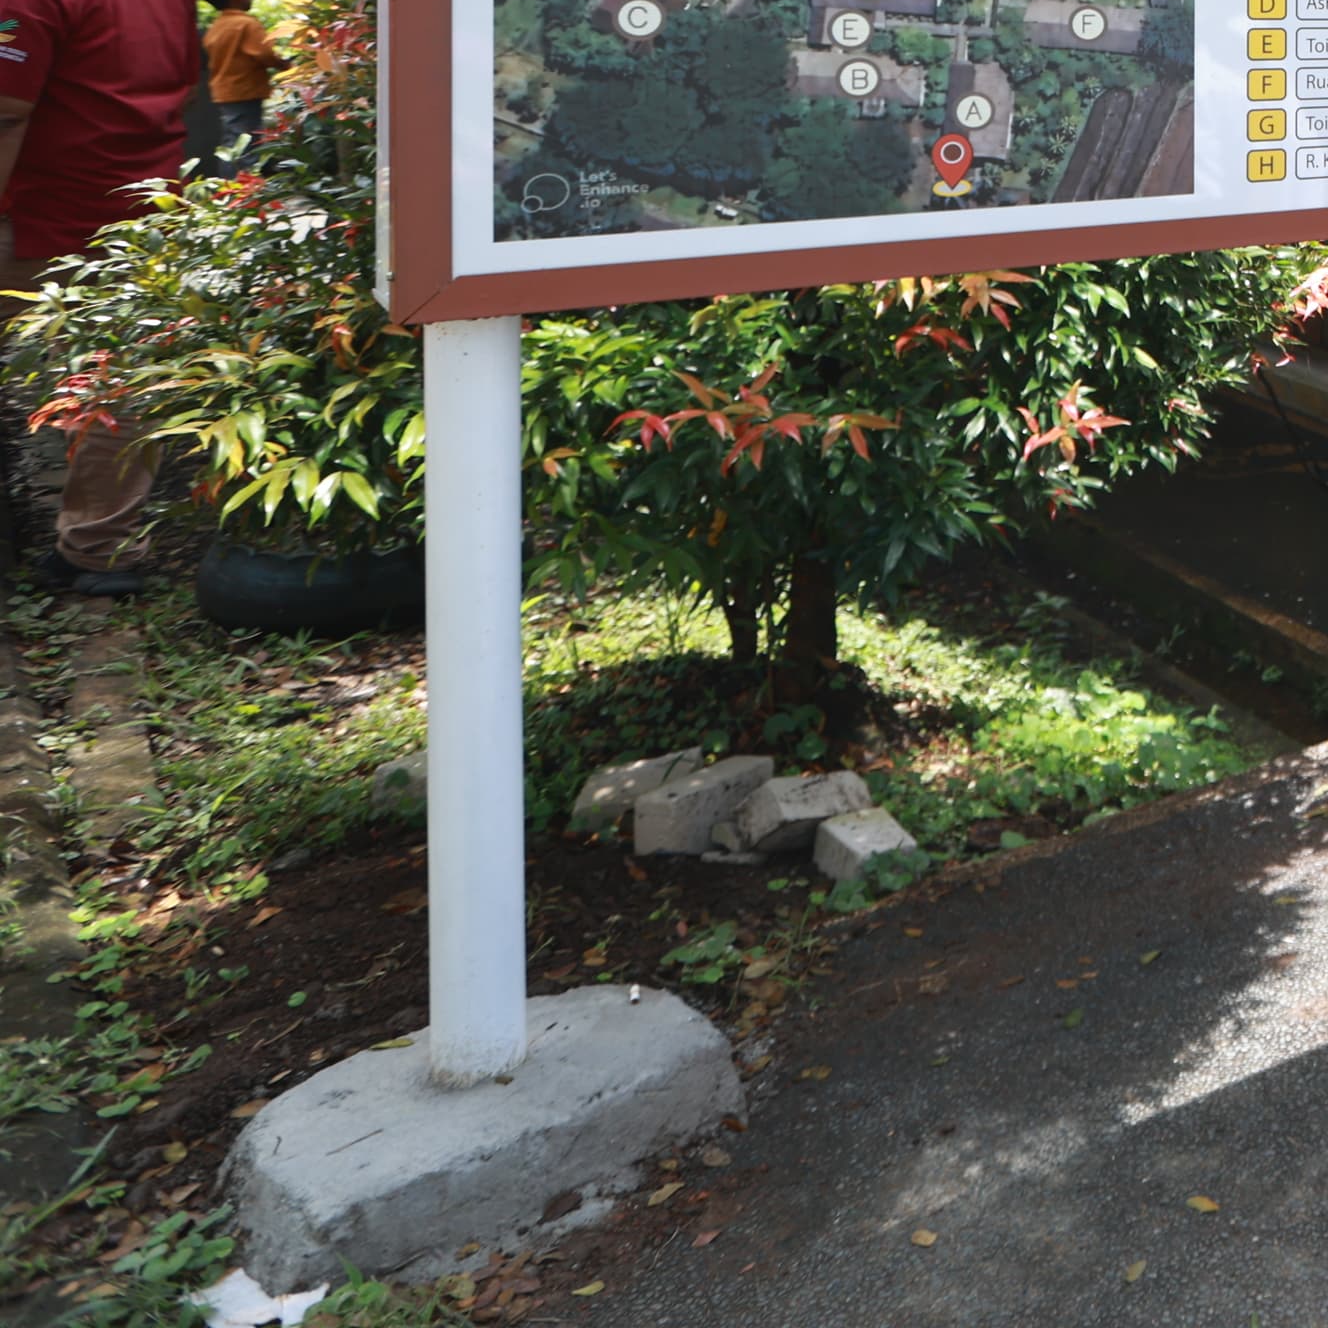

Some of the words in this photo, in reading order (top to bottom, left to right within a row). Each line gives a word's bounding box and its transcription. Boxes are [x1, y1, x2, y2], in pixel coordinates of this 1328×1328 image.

[627, 7, 648, 29] C
[1081, 15, 1096, 33] F
[842, 19, 859, 40] E
[1262, 35, 1273, 54] E
[852, 69, 869, 90] B
[1262, 75, 1272, 94] F
[964, 101, 982, 121] A
[1259, 115, 1274, 135] G
[1259, 156, 1274, 175] H
[1306, 154, 1319, 168] R.
[580, 183, 649, 196] Enhance
